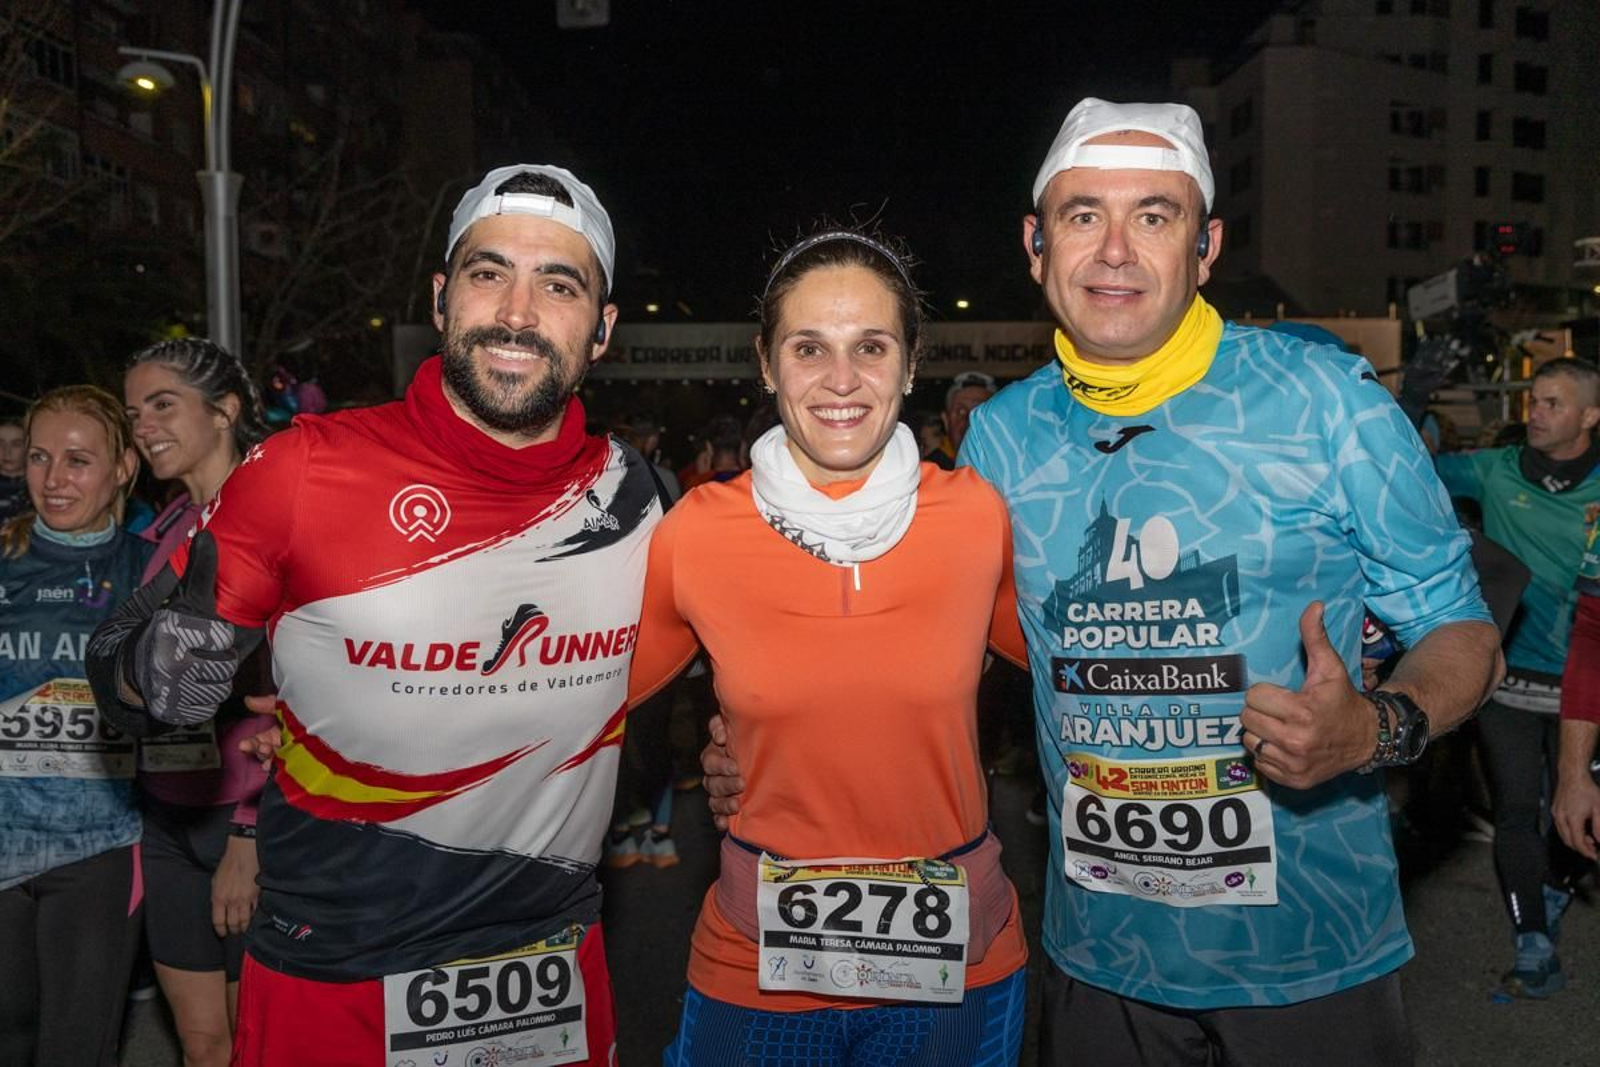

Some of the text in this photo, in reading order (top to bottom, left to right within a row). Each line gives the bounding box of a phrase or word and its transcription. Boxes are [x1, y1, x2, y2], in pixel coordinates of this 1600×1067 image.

[630, 346, 722, 364] CARRERA
[727, 345, 752, 364] UR
[1106, 515, 1180, 590] 40
[1067, 599, 1206, 623] CARRERA
[1064, 623, 1221, 650] POPULAR
[391, 681, 508, 696] Corredores
[517, 679, 539, 692] de
[1086, 664, 1230, 692] CaixaBank
[1080, 703, 1201, 717] VILLA DE
[1061, 715, 1243, 752] ARANJUEZ
[1095, 764, 1130, 793] 42
[1129, 766, 1170, 775] CARRERA
[1131, 780, 1158, 792] SAN
[1076, 794, 1251, 852] 6690
[1143, 853, 1183, 866] SERRANO
[777, 881, 952, 939] 6278
[820, 937, 852, 948] TERESA
[896, 944, 942, 955] PALOMINO
[406, 955, 572, 1028] 6509
[426, 1031, 455, 1042] PEDRO
[516, 1013, 557, 1027] PALOMINO
